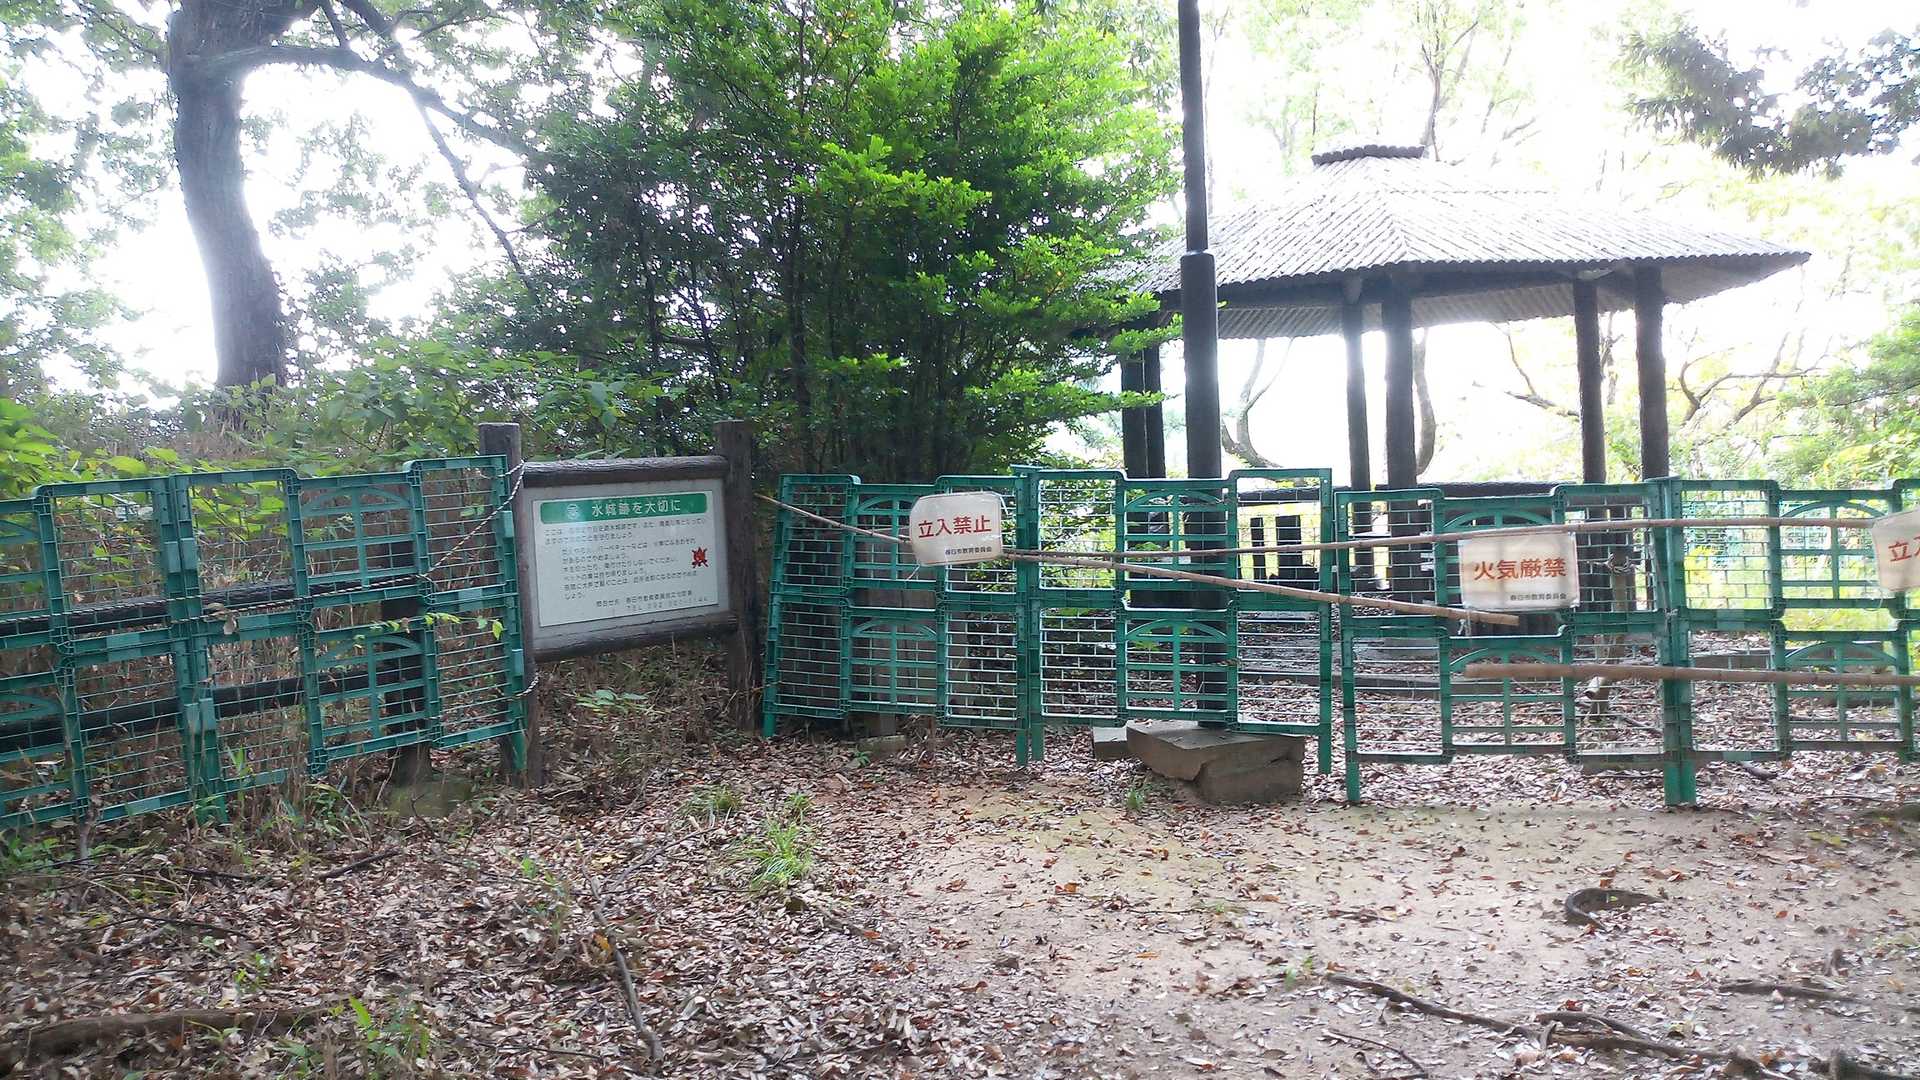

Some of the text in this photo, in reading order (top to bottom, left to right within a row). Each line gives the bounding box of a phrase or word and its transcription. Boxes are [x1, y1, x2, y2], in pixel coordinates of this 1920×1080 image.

[592, 499, 681, 518] 水城跡を大切に
[918, 515, 992, 538] 立入禁止
[1474, 556, 1566, 580] 火気厳禁
